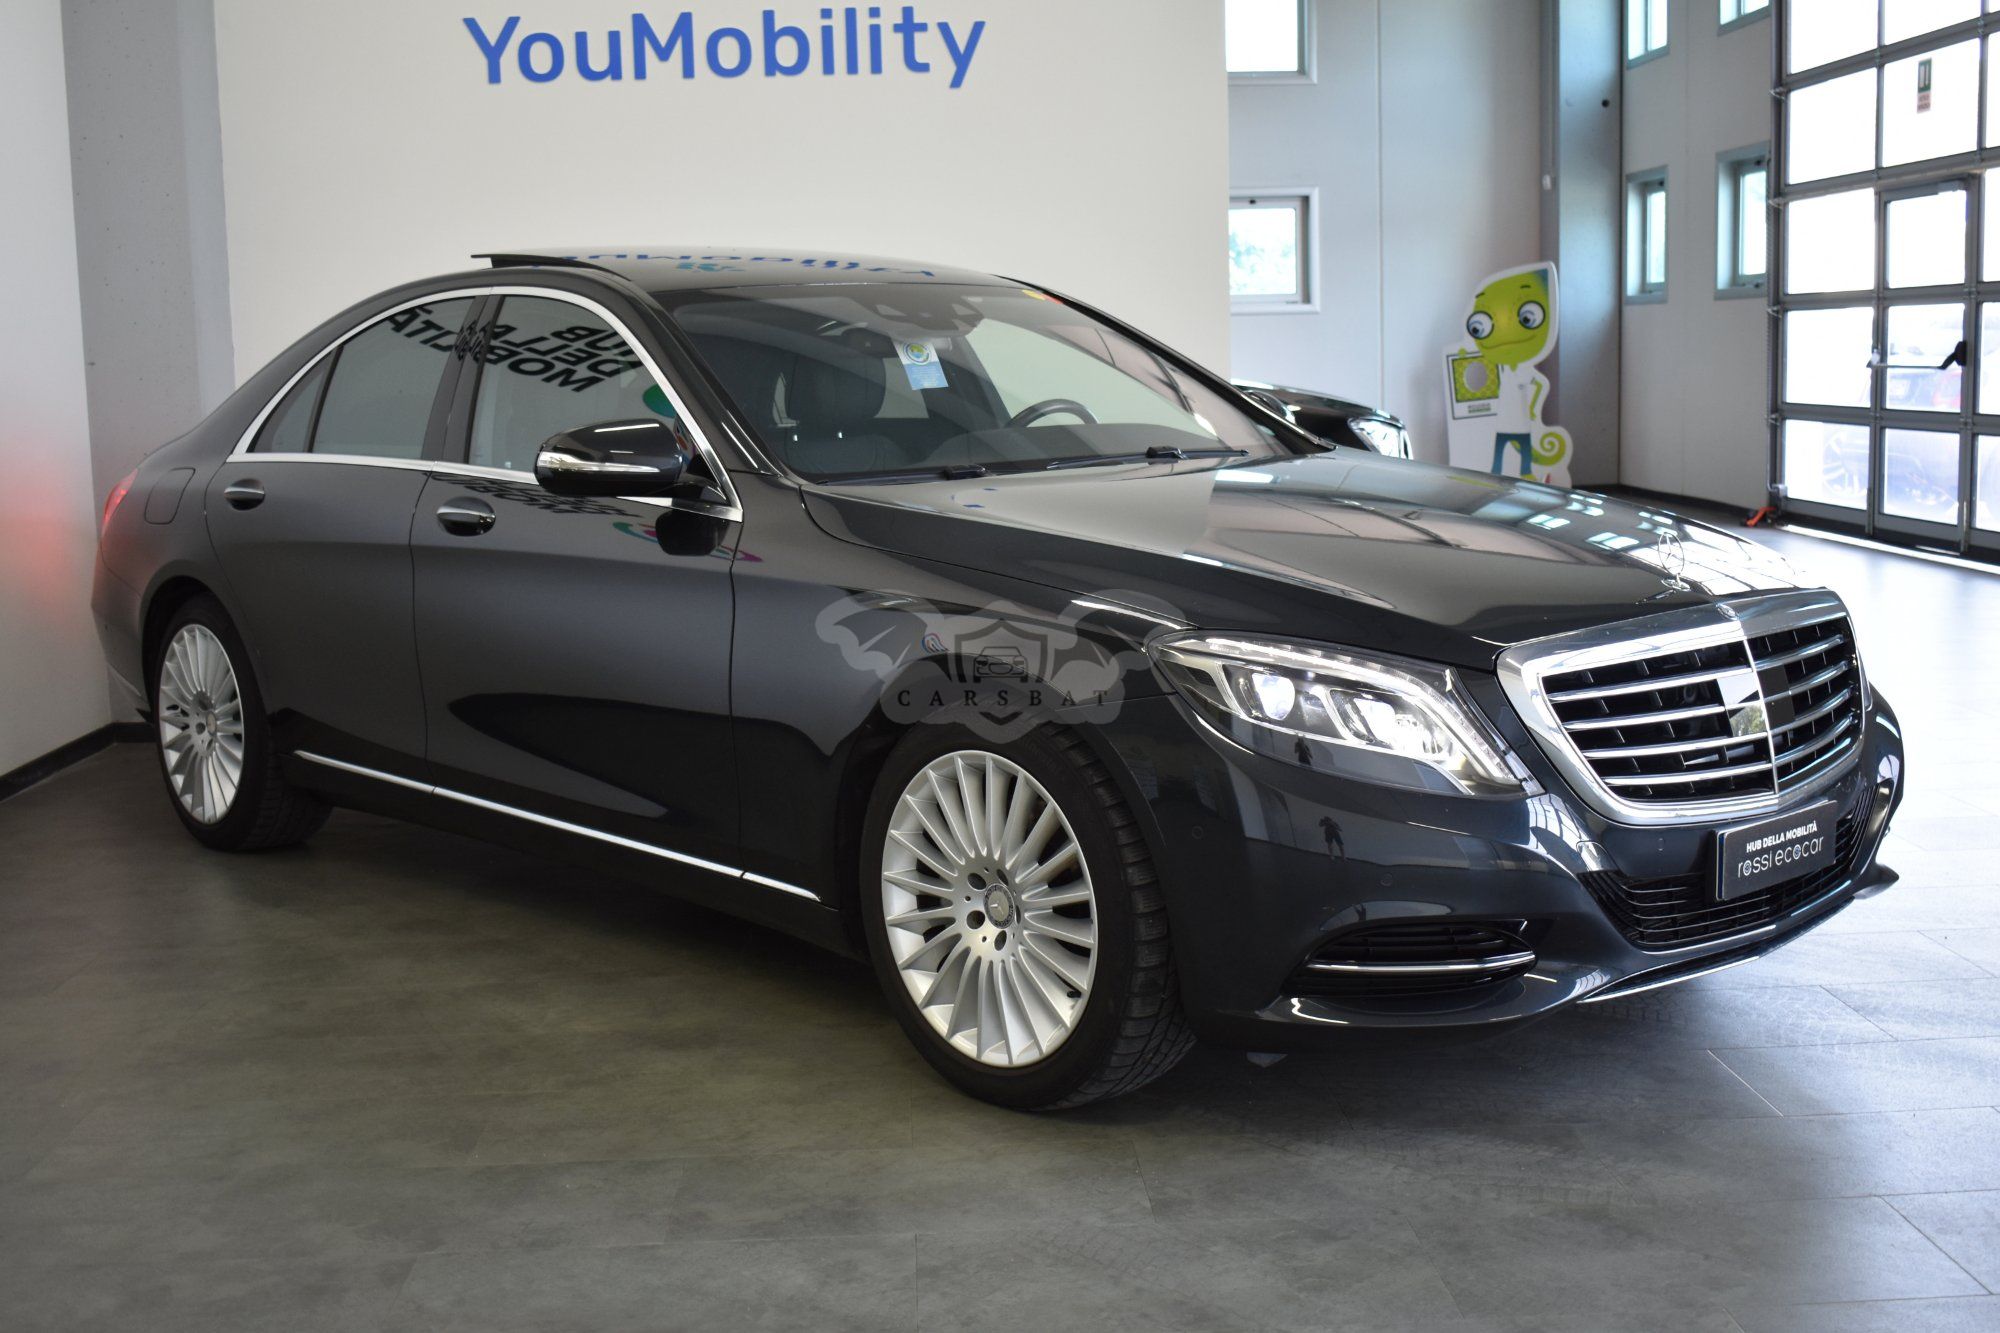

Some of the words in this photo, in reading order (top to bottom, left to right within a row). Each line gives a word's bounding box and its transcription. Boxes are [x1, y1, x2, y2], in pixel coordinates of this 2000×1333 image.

[462, 5, 987, 89] YouMobility
[1746, 839, 1762, 853] HUB
[1762, 831, 1785, 848] DELLA
[1785, 820, 1818, 841] MOBILITÀ
